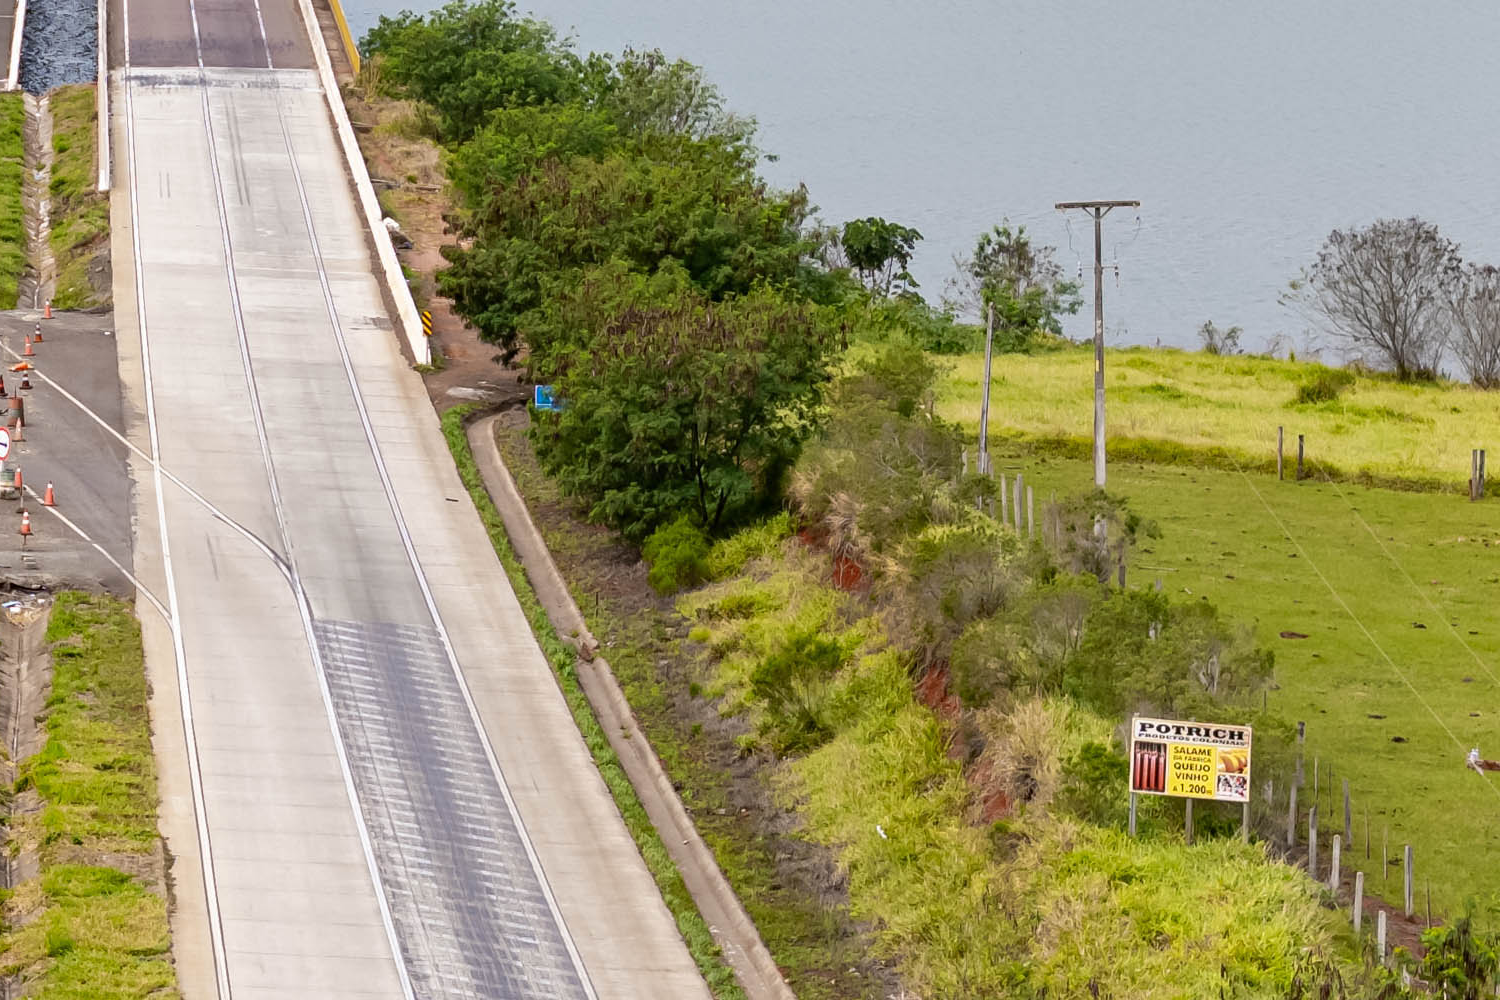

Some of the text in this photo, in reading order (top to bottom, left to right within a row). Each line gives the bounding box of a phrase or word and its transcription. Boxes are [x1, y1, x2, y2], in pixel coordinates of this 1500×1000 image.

[1140, 722, 1244, 740] POTRICH
[1138, 733, 1246, 747] PRODUTOS COLONIAIS
[1173, 746, 1212, 757] SALAME
[1174, 762, 1210, 772] QUEIJO
[1175, 772, 1209, 782] VINHO
